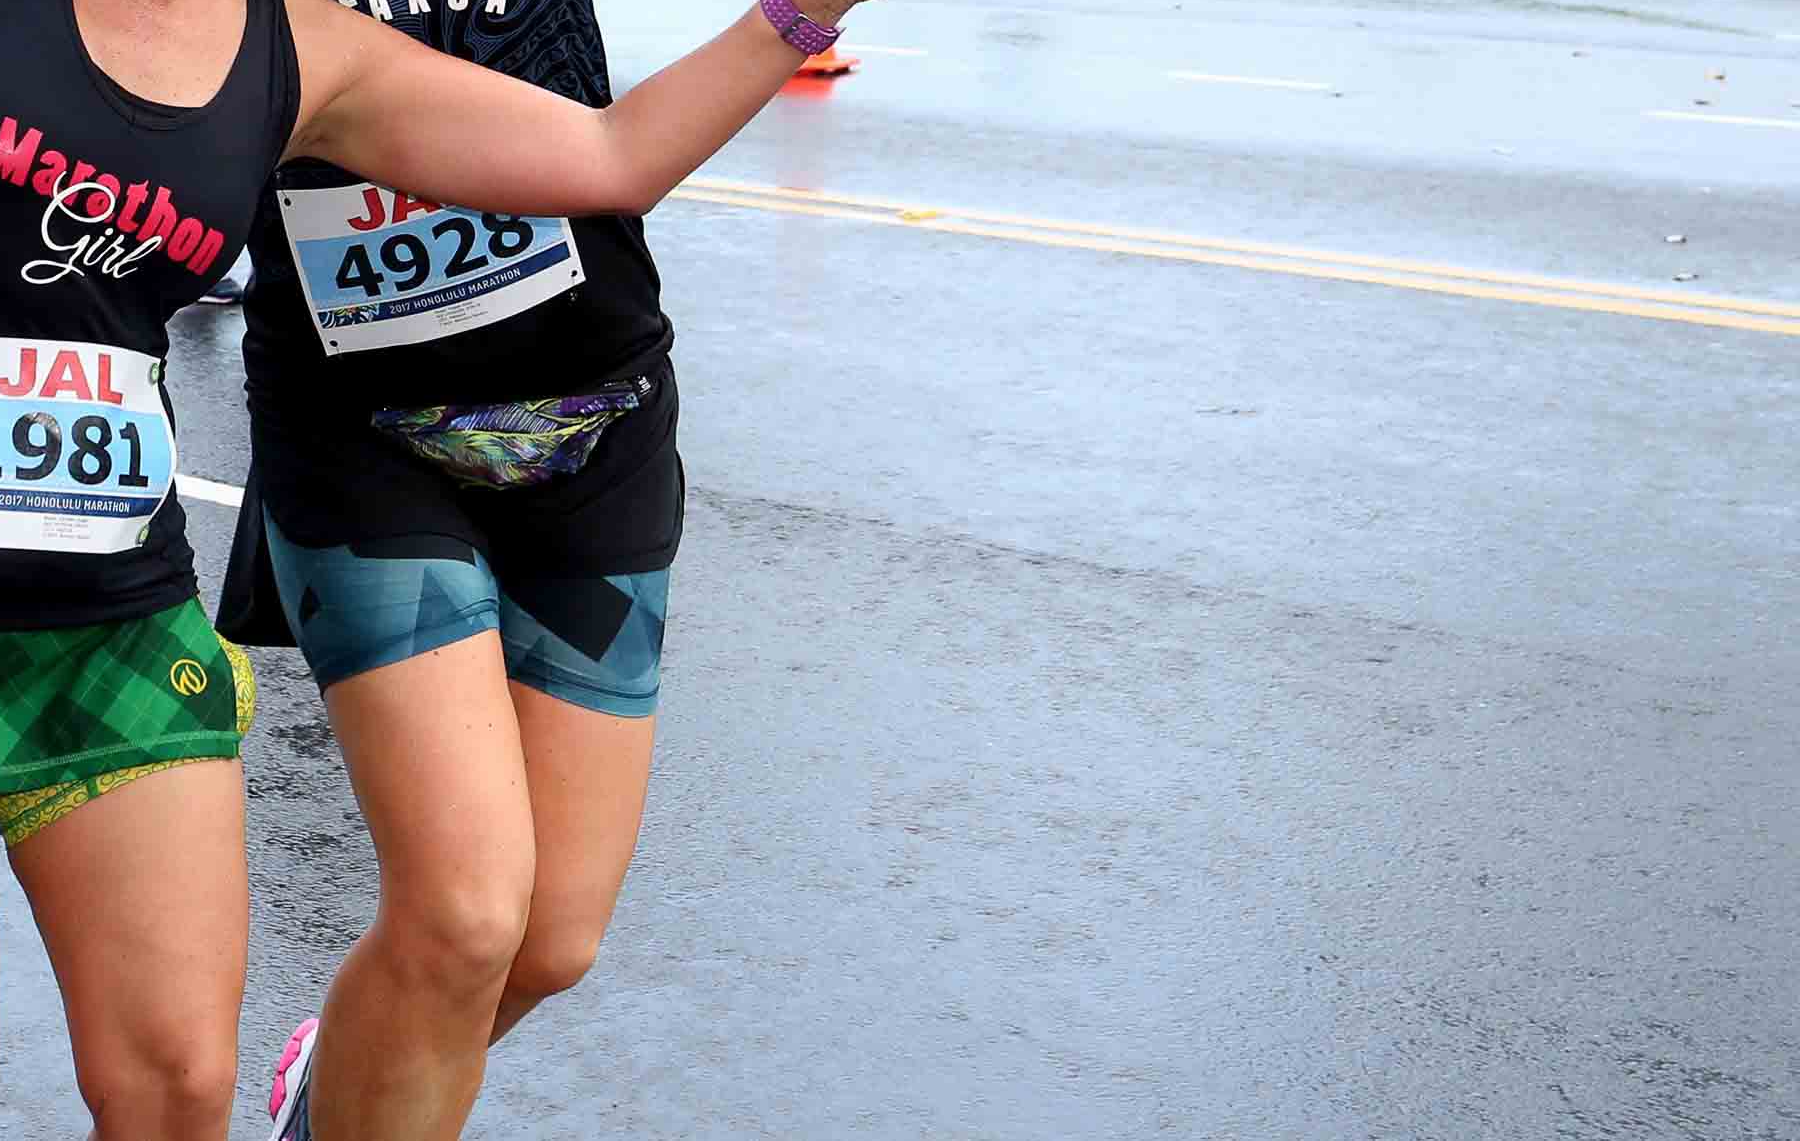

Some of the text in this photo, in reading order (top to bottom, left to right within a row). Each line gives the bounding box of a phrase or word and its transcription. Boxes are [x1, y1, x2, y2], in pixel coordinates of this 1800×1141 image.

[20, 170, 163, 285] Girl
[335, 212, 535, 298] 4928
[389, 302, 412, 316] 2017
[413, 287, 467, 310] HONOLULU
[468, 267, 522, 296] MARATHON
[25, 496, 82, 511] HONOLULU
[83, 499, 131, 514] MARATHON
